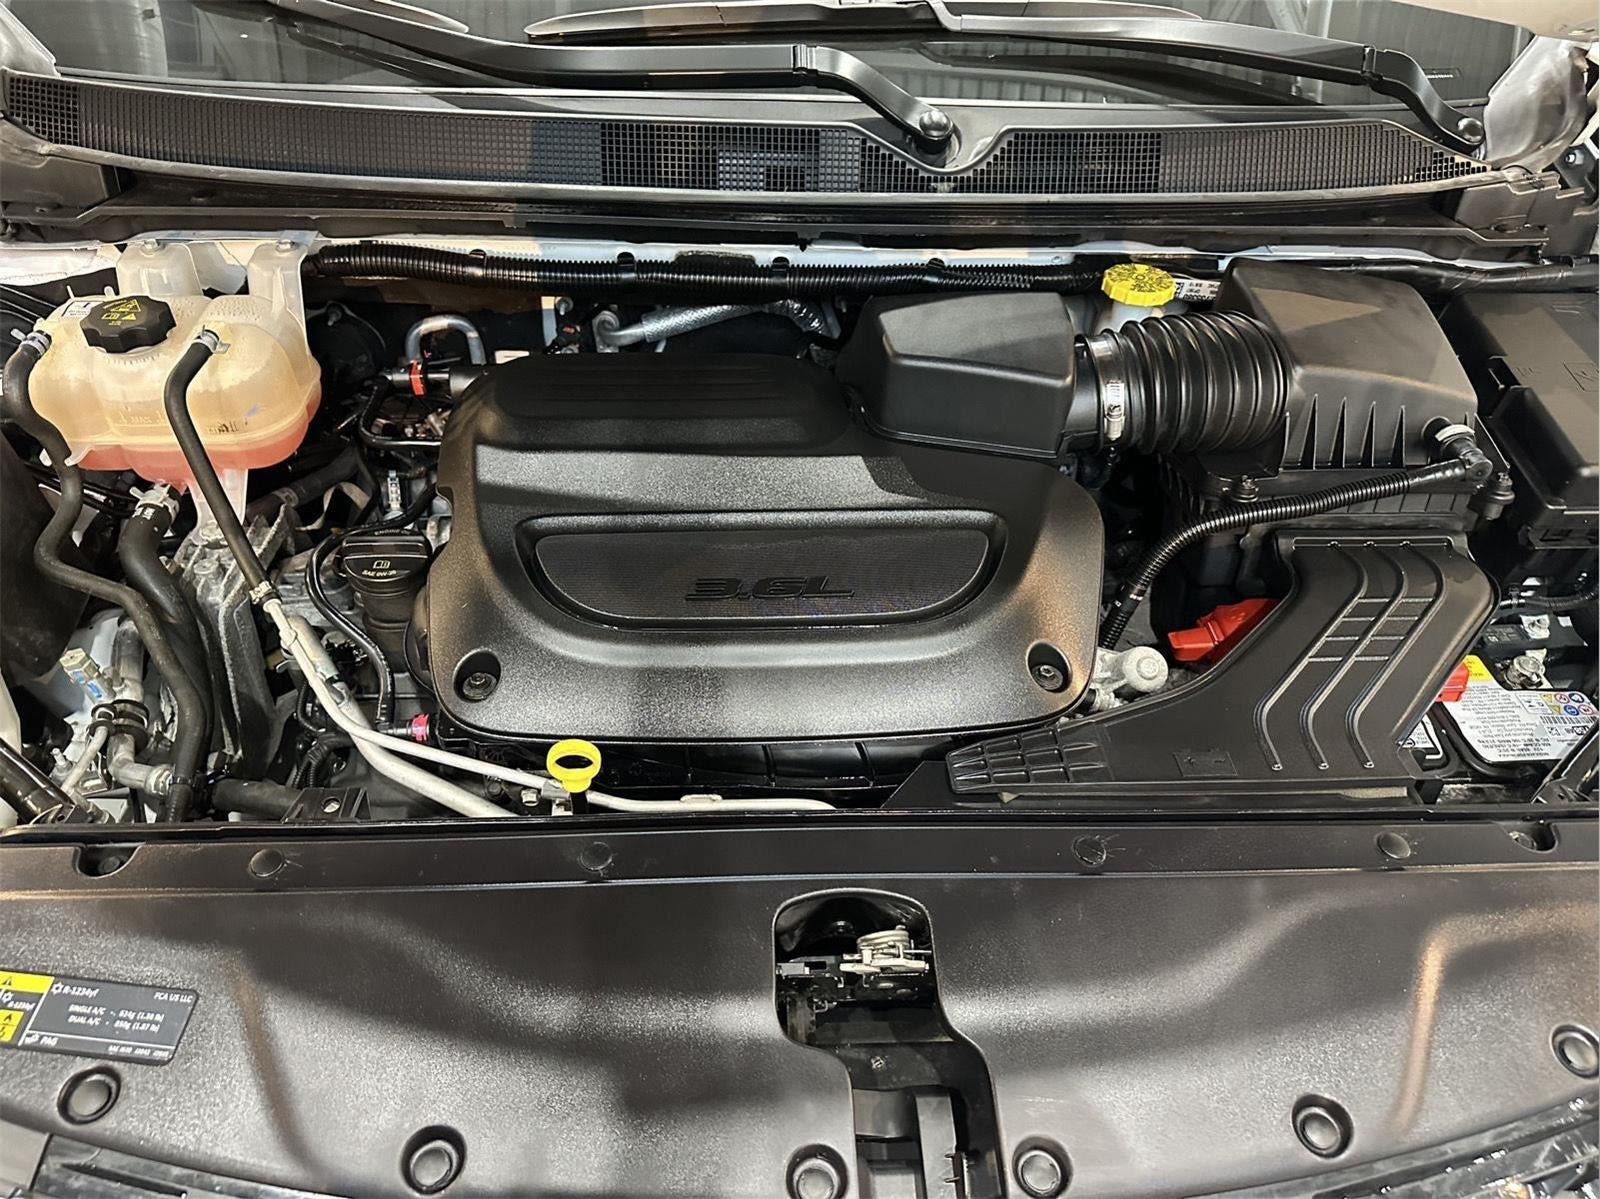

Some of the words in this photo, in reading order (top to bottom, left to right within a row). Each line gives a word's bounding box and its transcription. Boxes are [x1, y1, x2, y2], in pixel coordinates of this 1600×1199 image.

[685, 576, 855, 600] 3.6L
[154, 992, 168, 1000] FCA
[169, 993, 180, 1002] US
[180, 994, 194, 1003] LLC
[92, 1006, 106, 1016] A/C
[87, 1017, 101, 1026] A/C
[40, 1036, 58, 1046] PAG
